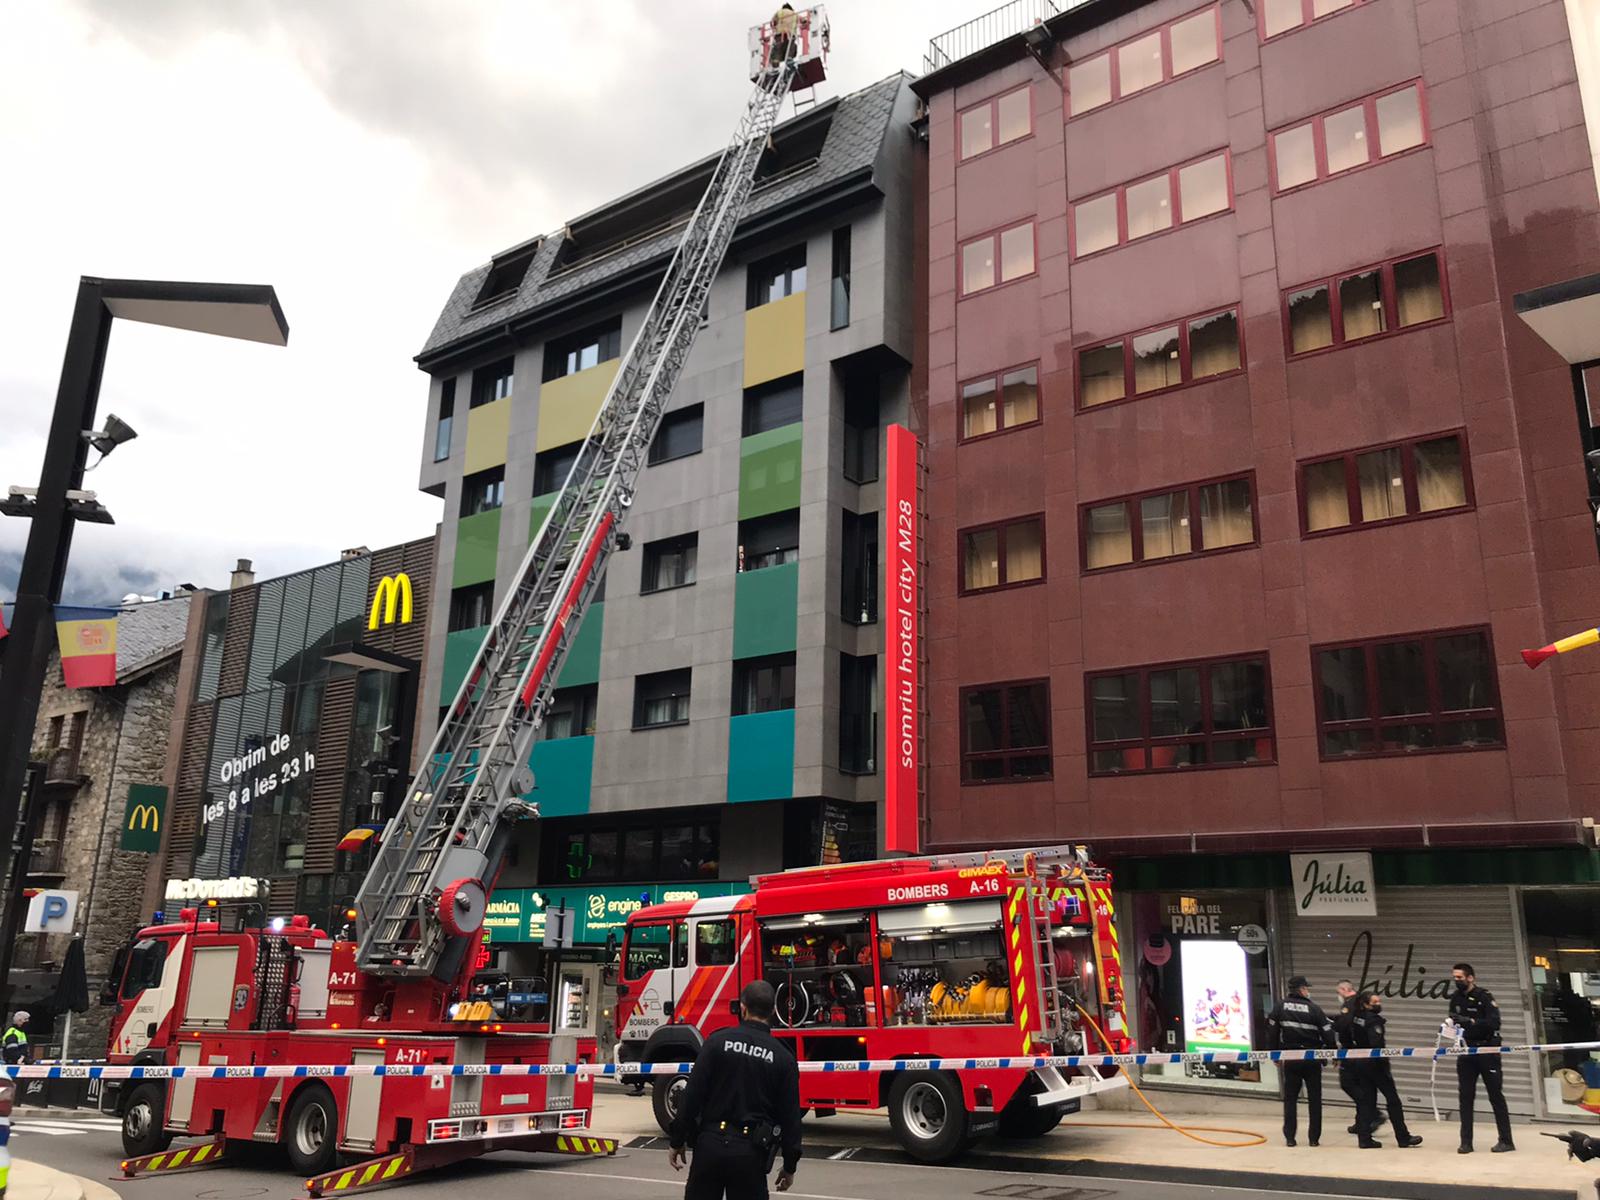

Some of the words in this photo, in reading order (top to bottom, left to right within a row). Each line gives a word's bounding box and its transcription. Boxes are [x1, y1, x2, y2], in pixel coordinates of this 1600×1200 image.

[898, 499, 913, 552] M28
[898, 559, 916, 604] city
[898, 608, 913, 673] hotel
[899, 680, 913, 769] somriu
[220, 746, 266, 782] Obrim
[270, 733, 290, 756] de
[203, 800, 224, 824] les
[228, 790, 237, 811] 8
[241, 787, 250, 804] a
[254, 773, 277, 797] les
[281, 757, 300, 784] 23
[304, 751, 315, 772] h
[958, 865, 1004, 878] GIMAEX
[165, 876, 259, 900] McDonald's
[969, 878, 999, 893] A-16
[1301, 859, 1367, 910] Júlia
[887, 883, 949, 901] BOMBERS
[40, 896, 68, 928] P
[485, 900, 520, 913] ARMÀCIA
[608, 897, 641, 915] engine
[1096, 904, 1108, 916] -16
[1207, 904, 1222, 914] DEL
[1171, 915, 1220, 934] PARE
[328, 971, 357, 985] A-71
[1283, 1002, 1309, 1013] POLICIA
[629, 1018, 659, 1026] BOMBERS
[395, 1047, 421, 1063] A-71
[724, 1040, 774, 1063] POLICIA
[1315, 1050, 1335, 1058] POLICIA
[1381, 1048, 1401, 1056] POLICIA
[976, 1060, 997, 1068] POLICIA
[1045, 1058, 1066, 1066] POLICIA
[1112, 1056, 1134, 1064] POLICIA
[1181, 1054, 1201, 1062] POLICIA
[308, 1068, 332, 1076] POLICIA
[386, 1067, 410, 1075] POLICIA
[464, 1066, 487, 1074] POLICIA
[540, 1066, 564, 1074] POLICIA
[615, 1065, 638, 1073] POLICIA
[834, 1062, 856, 1070] POLICIA
[62, 1068, 86, 1077] POLICIA
[145, 1068, 169, 1077] POLICIA
[227, 1068, 251, 1077] POLICIA
